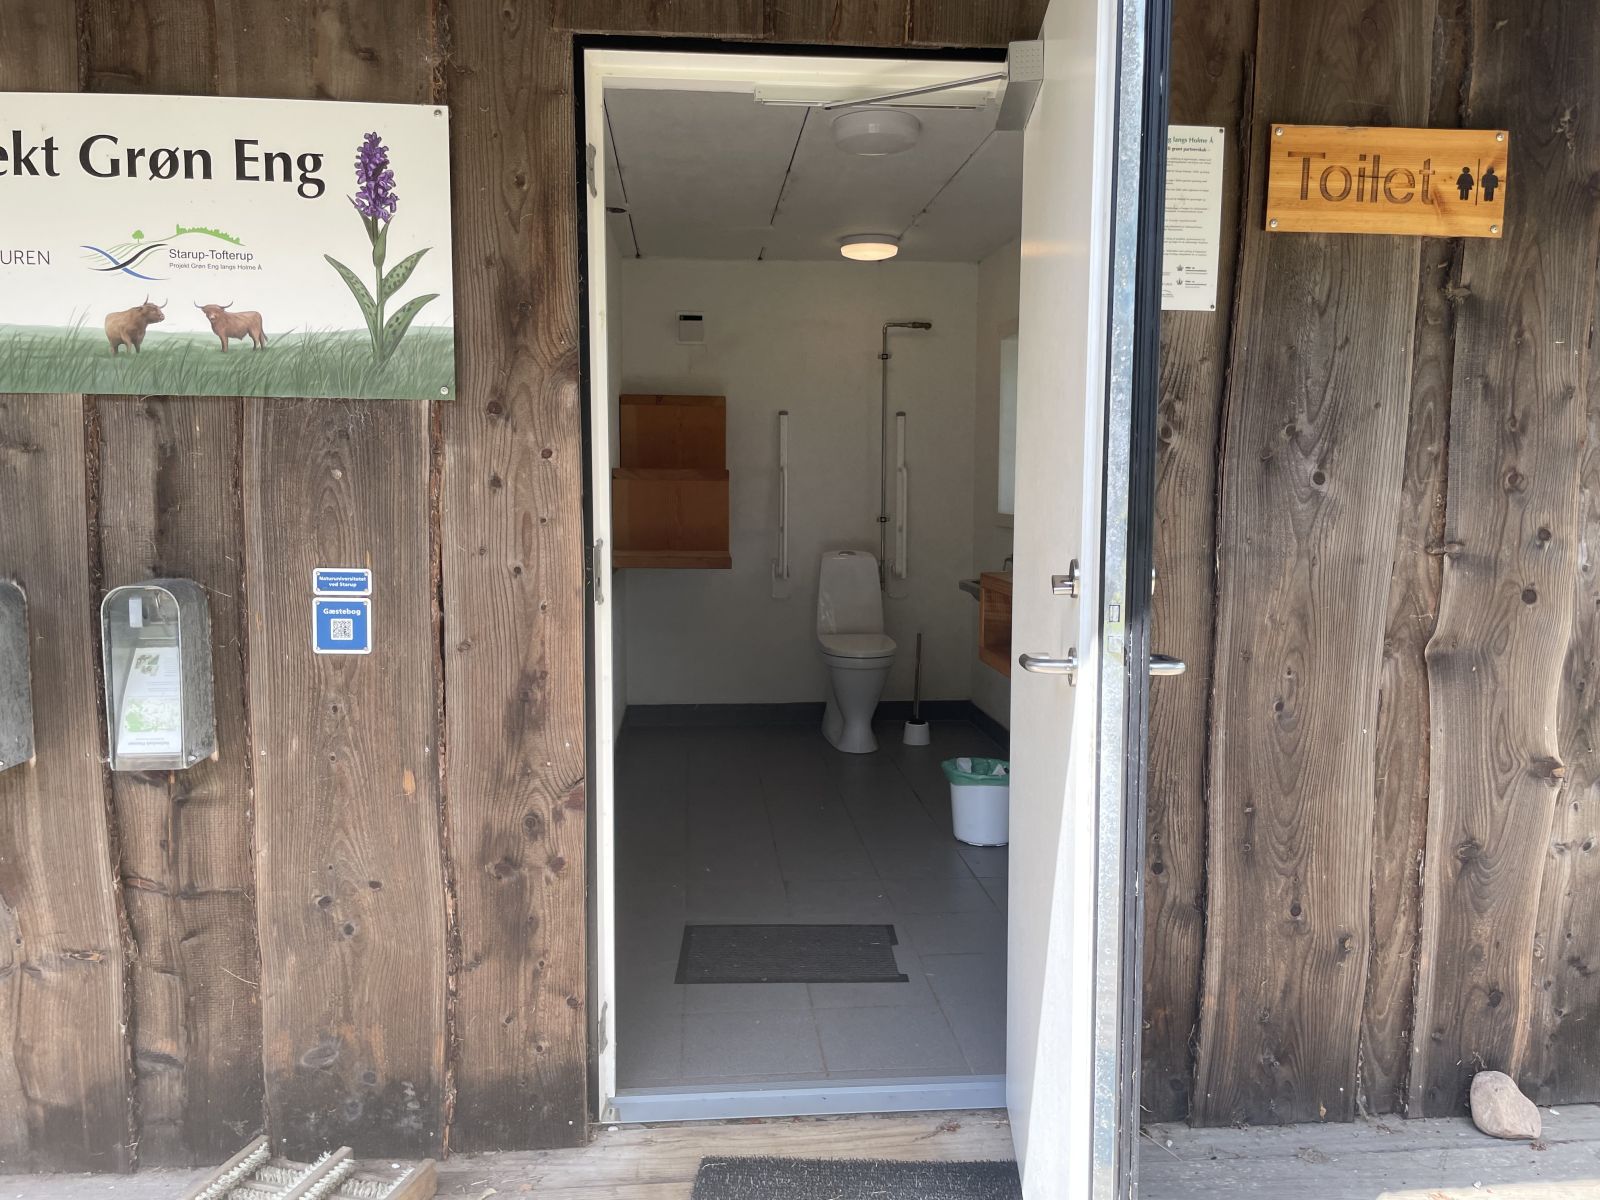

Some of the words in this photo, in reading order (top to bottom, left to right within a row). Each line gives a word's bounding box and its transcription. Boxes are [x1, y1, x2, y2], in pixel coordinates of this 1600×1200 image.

[79, 133, 213, 182] Grøn
[234, 138, 326, 199] Eng
[1287, 151, 1436, 205] Toilet
[169, 248, 254, 262] Starup-Tofterup
[169, 262, 190, 270] Projekt
[323, 608, 361, 616] Gæstebog
